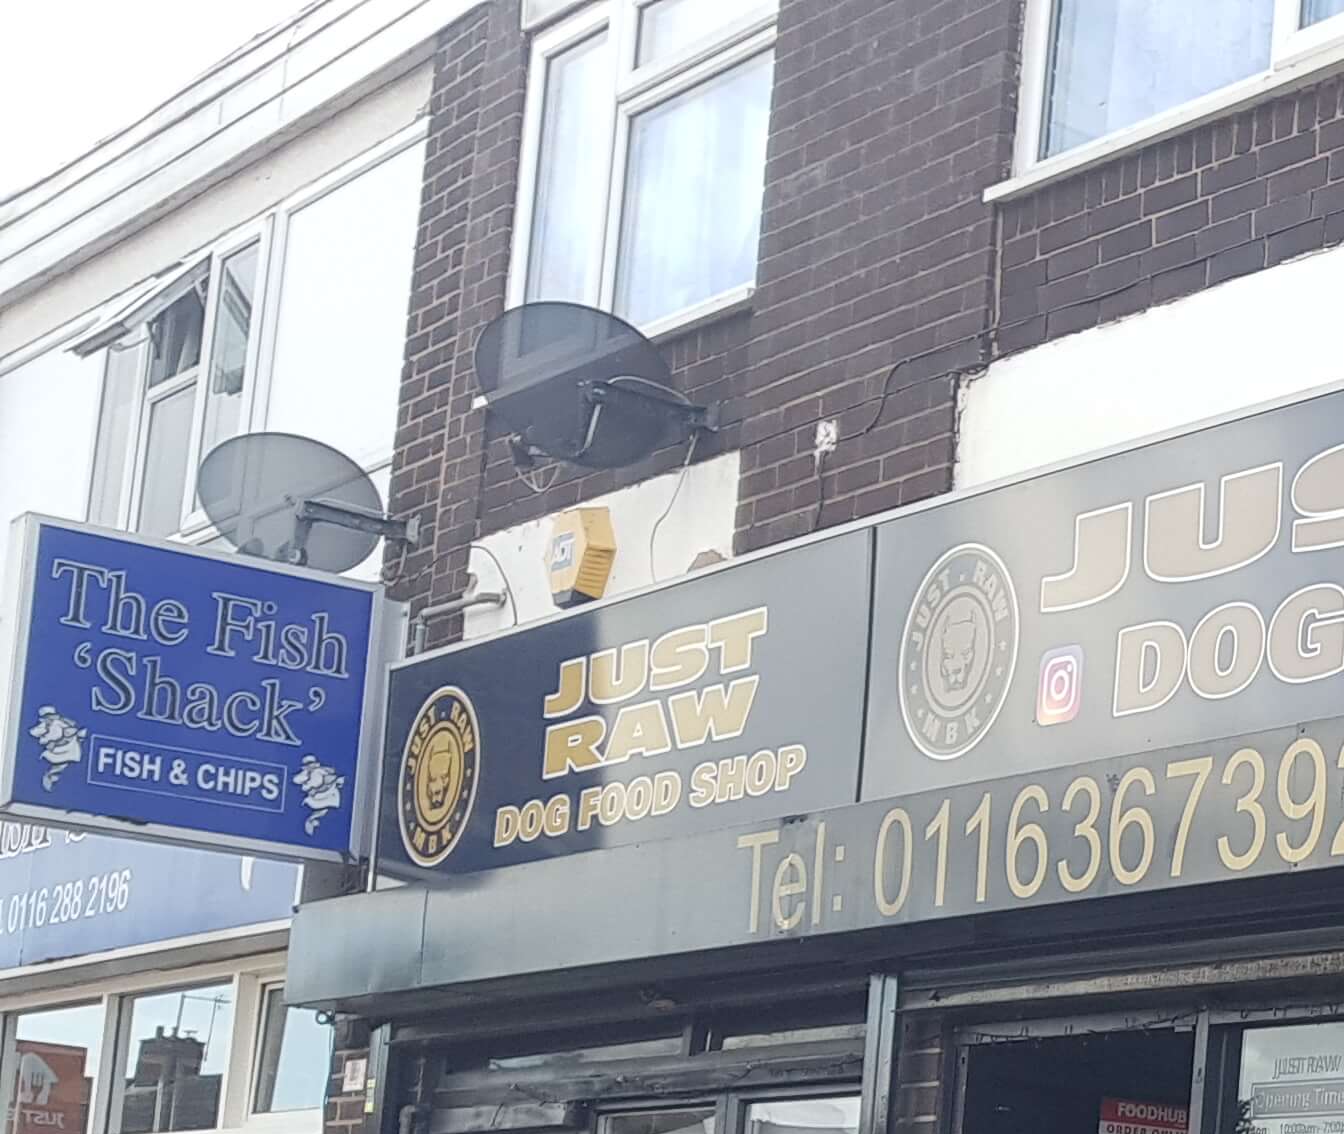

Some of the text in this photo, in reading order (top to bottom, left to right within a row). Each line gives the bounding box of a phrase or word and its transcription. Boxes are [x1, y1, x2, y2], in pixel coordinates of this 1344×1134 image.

[52, 558, 348, 679] The Fish
[911, 560, 1009, 650] JUST RAW
[543, 606, 768, 718] JUST
[99, 748, 279, 799] FISH & CHIPS
[407, 701, 474, 775] JUST RAW
[542, 675, 759, 780] RAW
[493, 744, 807, 848] DOG FOOD SHOP
[8, 868, 132, 934] 0116 288 2196
[737, 822, 846, 934] Tel:
[1118, 1102, 1187, 1123] FOODHUB
